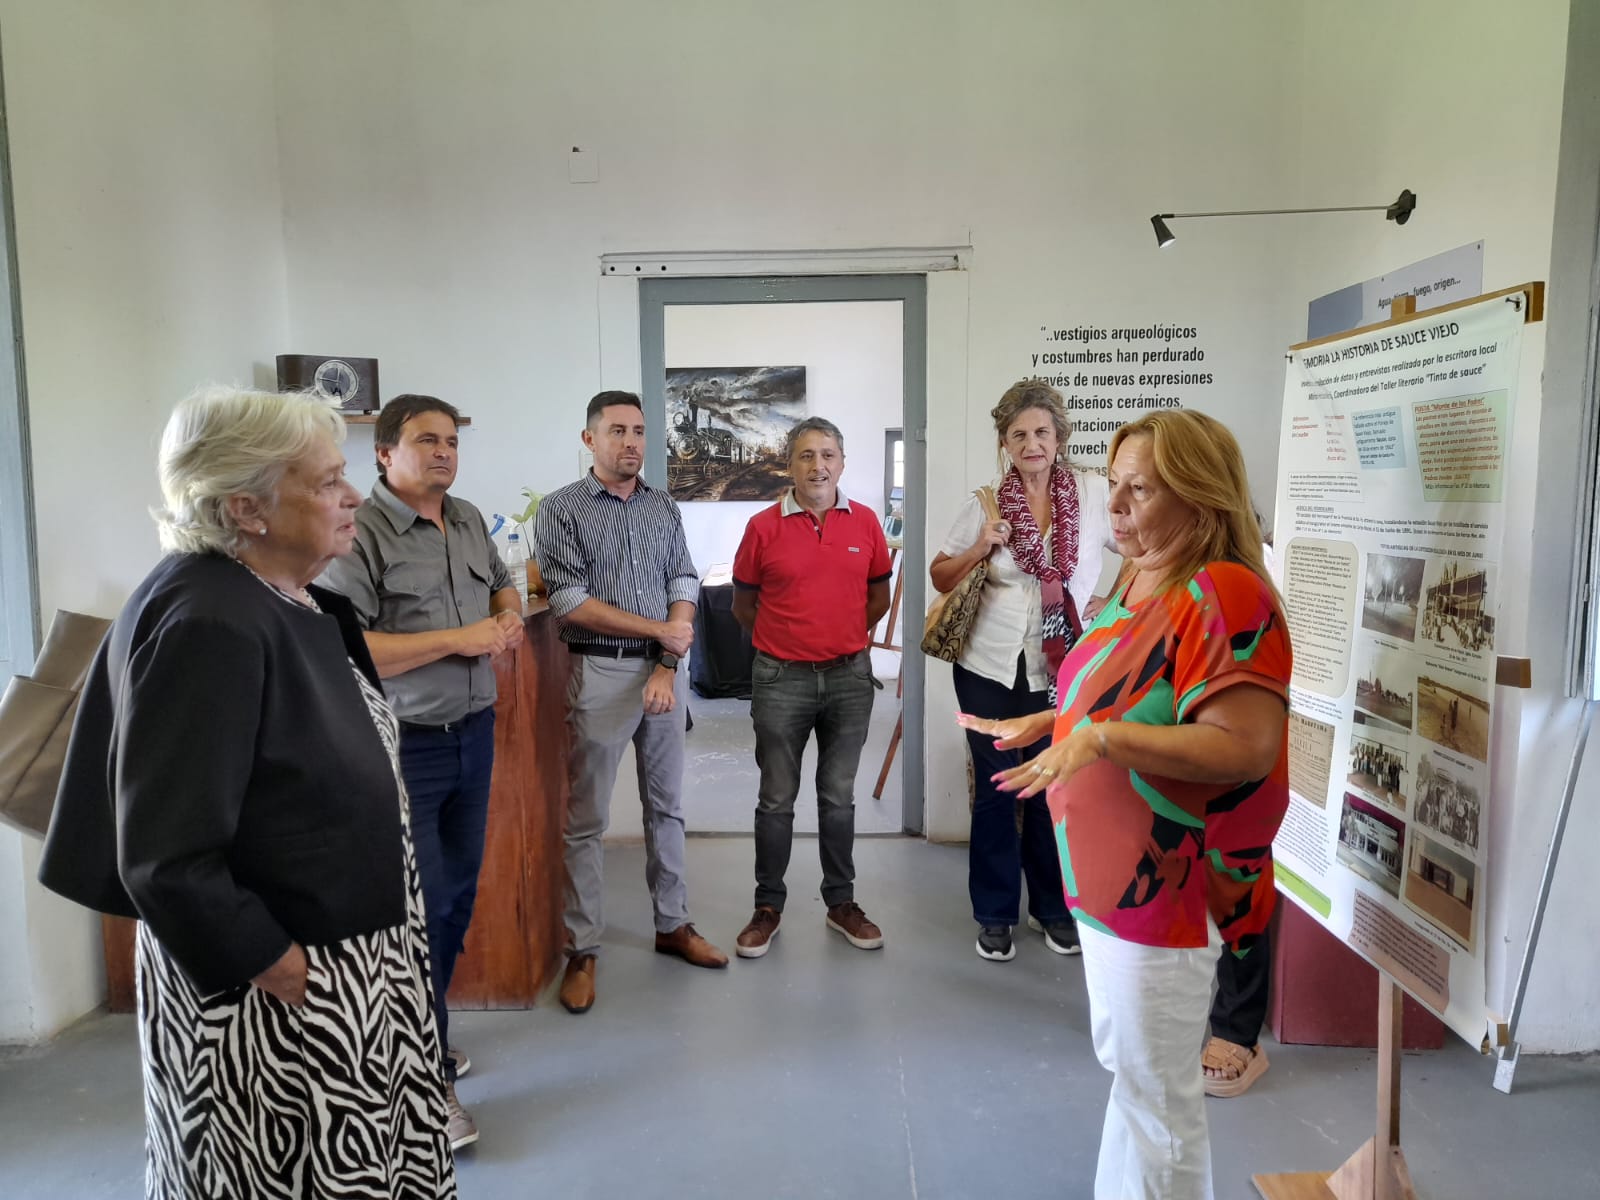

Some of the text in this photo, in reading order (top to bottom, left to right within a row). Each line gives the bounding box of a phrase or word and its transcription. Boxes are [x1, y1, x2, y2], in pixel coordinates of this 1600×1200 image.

[1111, 324, 1197, 342] arqueológicos
[1331, 351, 1341, 363] LA
[1341, 341, 1380, 361] HISTORIA
[1380, 338, 1394, 352] DE
[1394, 330, 1427, 348] SAUCE
[1428, 322, 1459, 340] VIEJO
[1032, 347, 1204, 367] y costumbres han perdurado
[1359, 367, 1391, 379] entrevistas
[1391, 358, 1421, 372] realizada
[1422, 357, 1435, 368] por
[1436, 353, 1444, 363] la
[1444, 348, 1477, 362] escritora
[1479, 342, 1498, 356] local
[1074, 372, 1088, 387] de
[1092, 373, 1135, 387] nuevas
[1139, 370, 1213, 388] expresiones
[1370, 382, 1379, 393] del
[1380, 379, 1397, 391] Taller
[1398, 375, 1424, 387] literario
[1448, 368, 1458, 379] de
[1067, 394, 1113, 409] diseños
